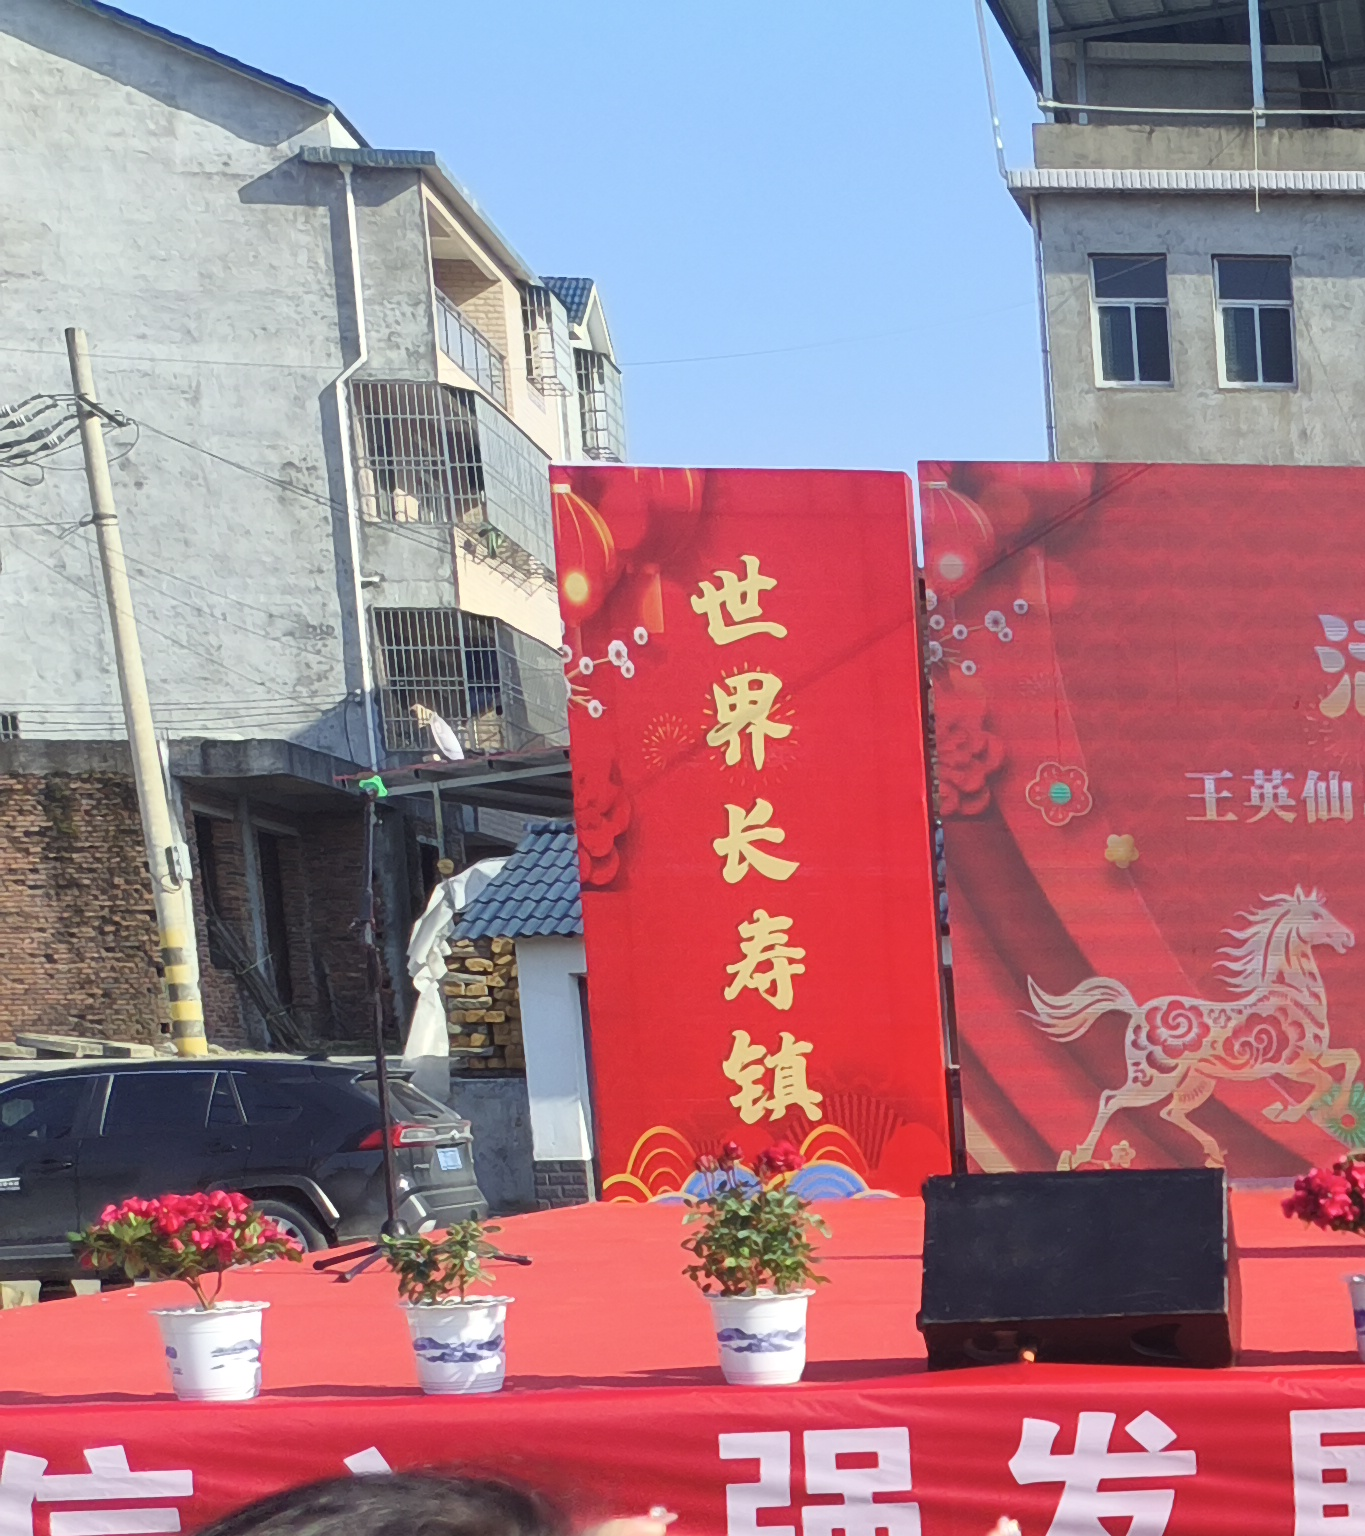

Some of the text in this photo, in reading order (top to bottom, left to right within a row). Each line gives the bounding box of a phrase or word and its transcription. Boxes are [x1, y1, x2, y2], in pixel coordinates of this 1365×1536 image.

[690, 555, 823, 1125] 世界长寿镇
